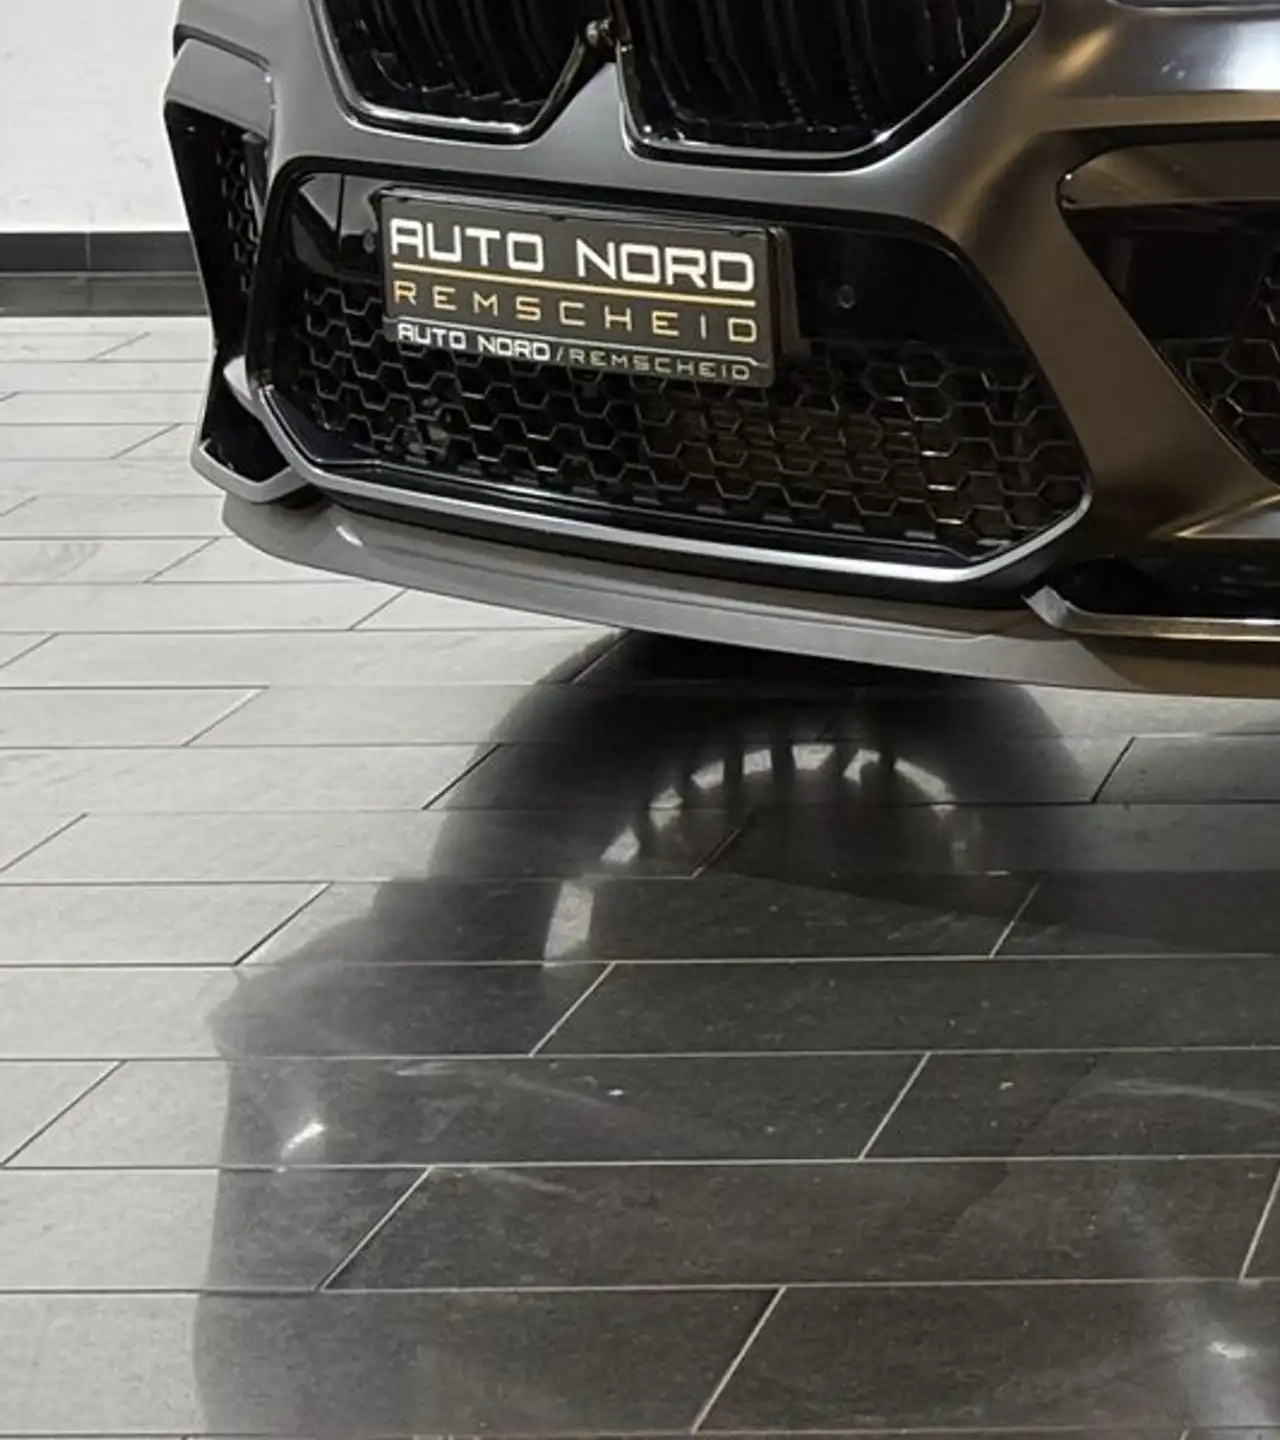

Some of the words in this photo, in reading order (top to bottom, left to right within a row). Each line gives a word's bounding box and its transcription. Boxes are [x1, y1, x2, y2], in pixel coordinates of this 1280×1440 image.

[389, 218, 545, 272] AUTO
[576, 238, 756, 292] NORD
[392, 280, 758, 343] REMSCHEID
[396, 323, 467, 351] AUTO
